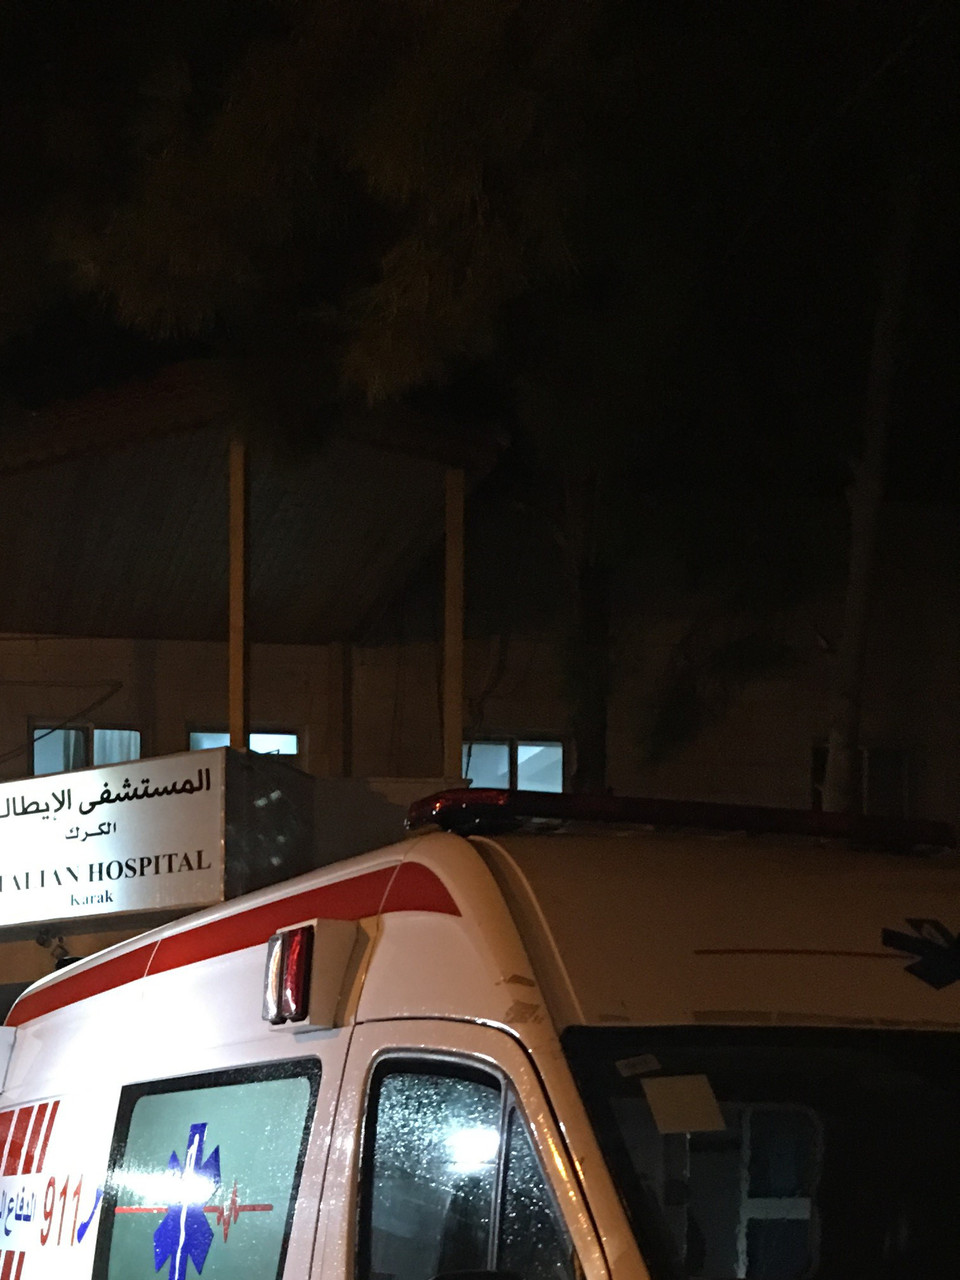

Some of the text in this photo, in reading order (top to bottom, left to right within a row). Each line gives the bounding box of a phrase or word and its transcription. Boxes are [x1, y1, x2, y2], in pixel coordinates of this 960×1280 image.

[79, 768, 211, 815] المستشفى
[65, 822, 117, 842] الكرك
[88, 849, 212, 882] HOSPITAL
[70, 890, 113, 906] Karak
[40, 1174, 84, 1247] 911
